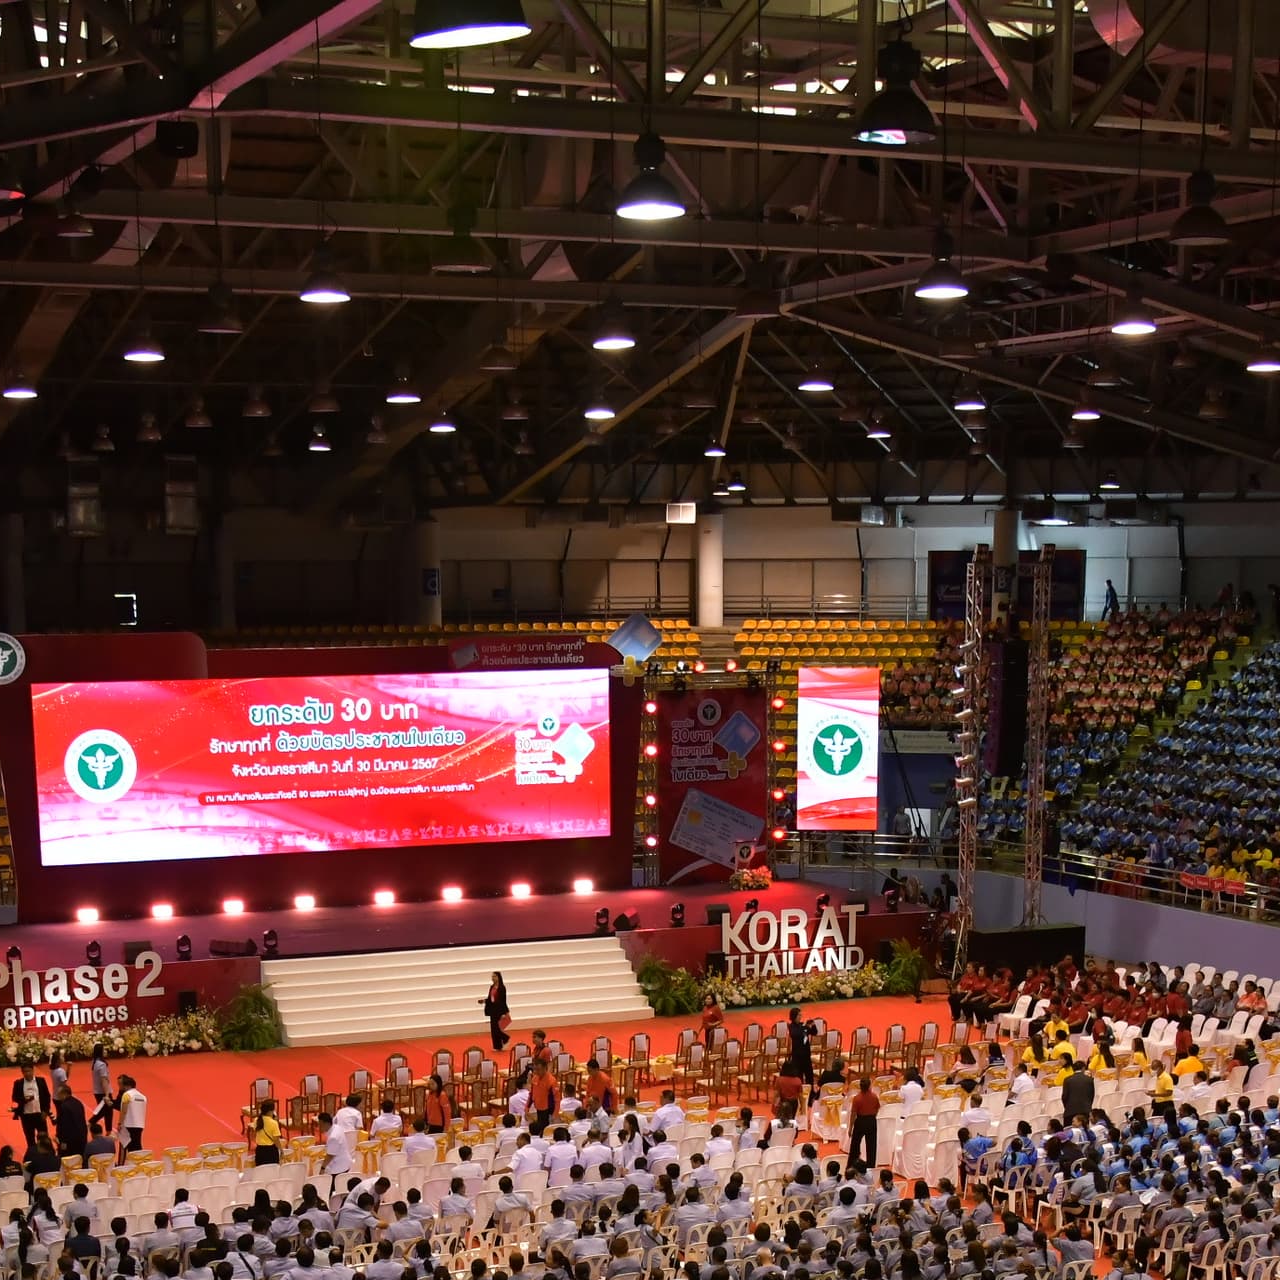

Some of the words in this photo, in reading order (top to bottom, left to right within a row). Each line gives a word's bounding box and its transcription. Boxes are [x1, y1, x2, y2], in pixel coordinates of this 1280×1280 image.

[250, 697, 333, 726] ยกระดับ
[341, 698, 371, 721] 30
[381, 701, 418, 721] บาท
[209, 733, 272, 756] รักษาทุกที่
[276, 726, 466, 752] ด้วยบัตรประชาชนใบเดียว
[232, 763, 328, 778] จังหวัดนครราชสีมา
[332, 759, 353, 773] วันที่
[357, 761, 371, 772] 30
[373, 758, 409, 772] มีนาคม
[412, 757, 438, 770] 2567
[721, 903, 865, 954] KORAT
[724, 946, 864, 979] THAILAND
